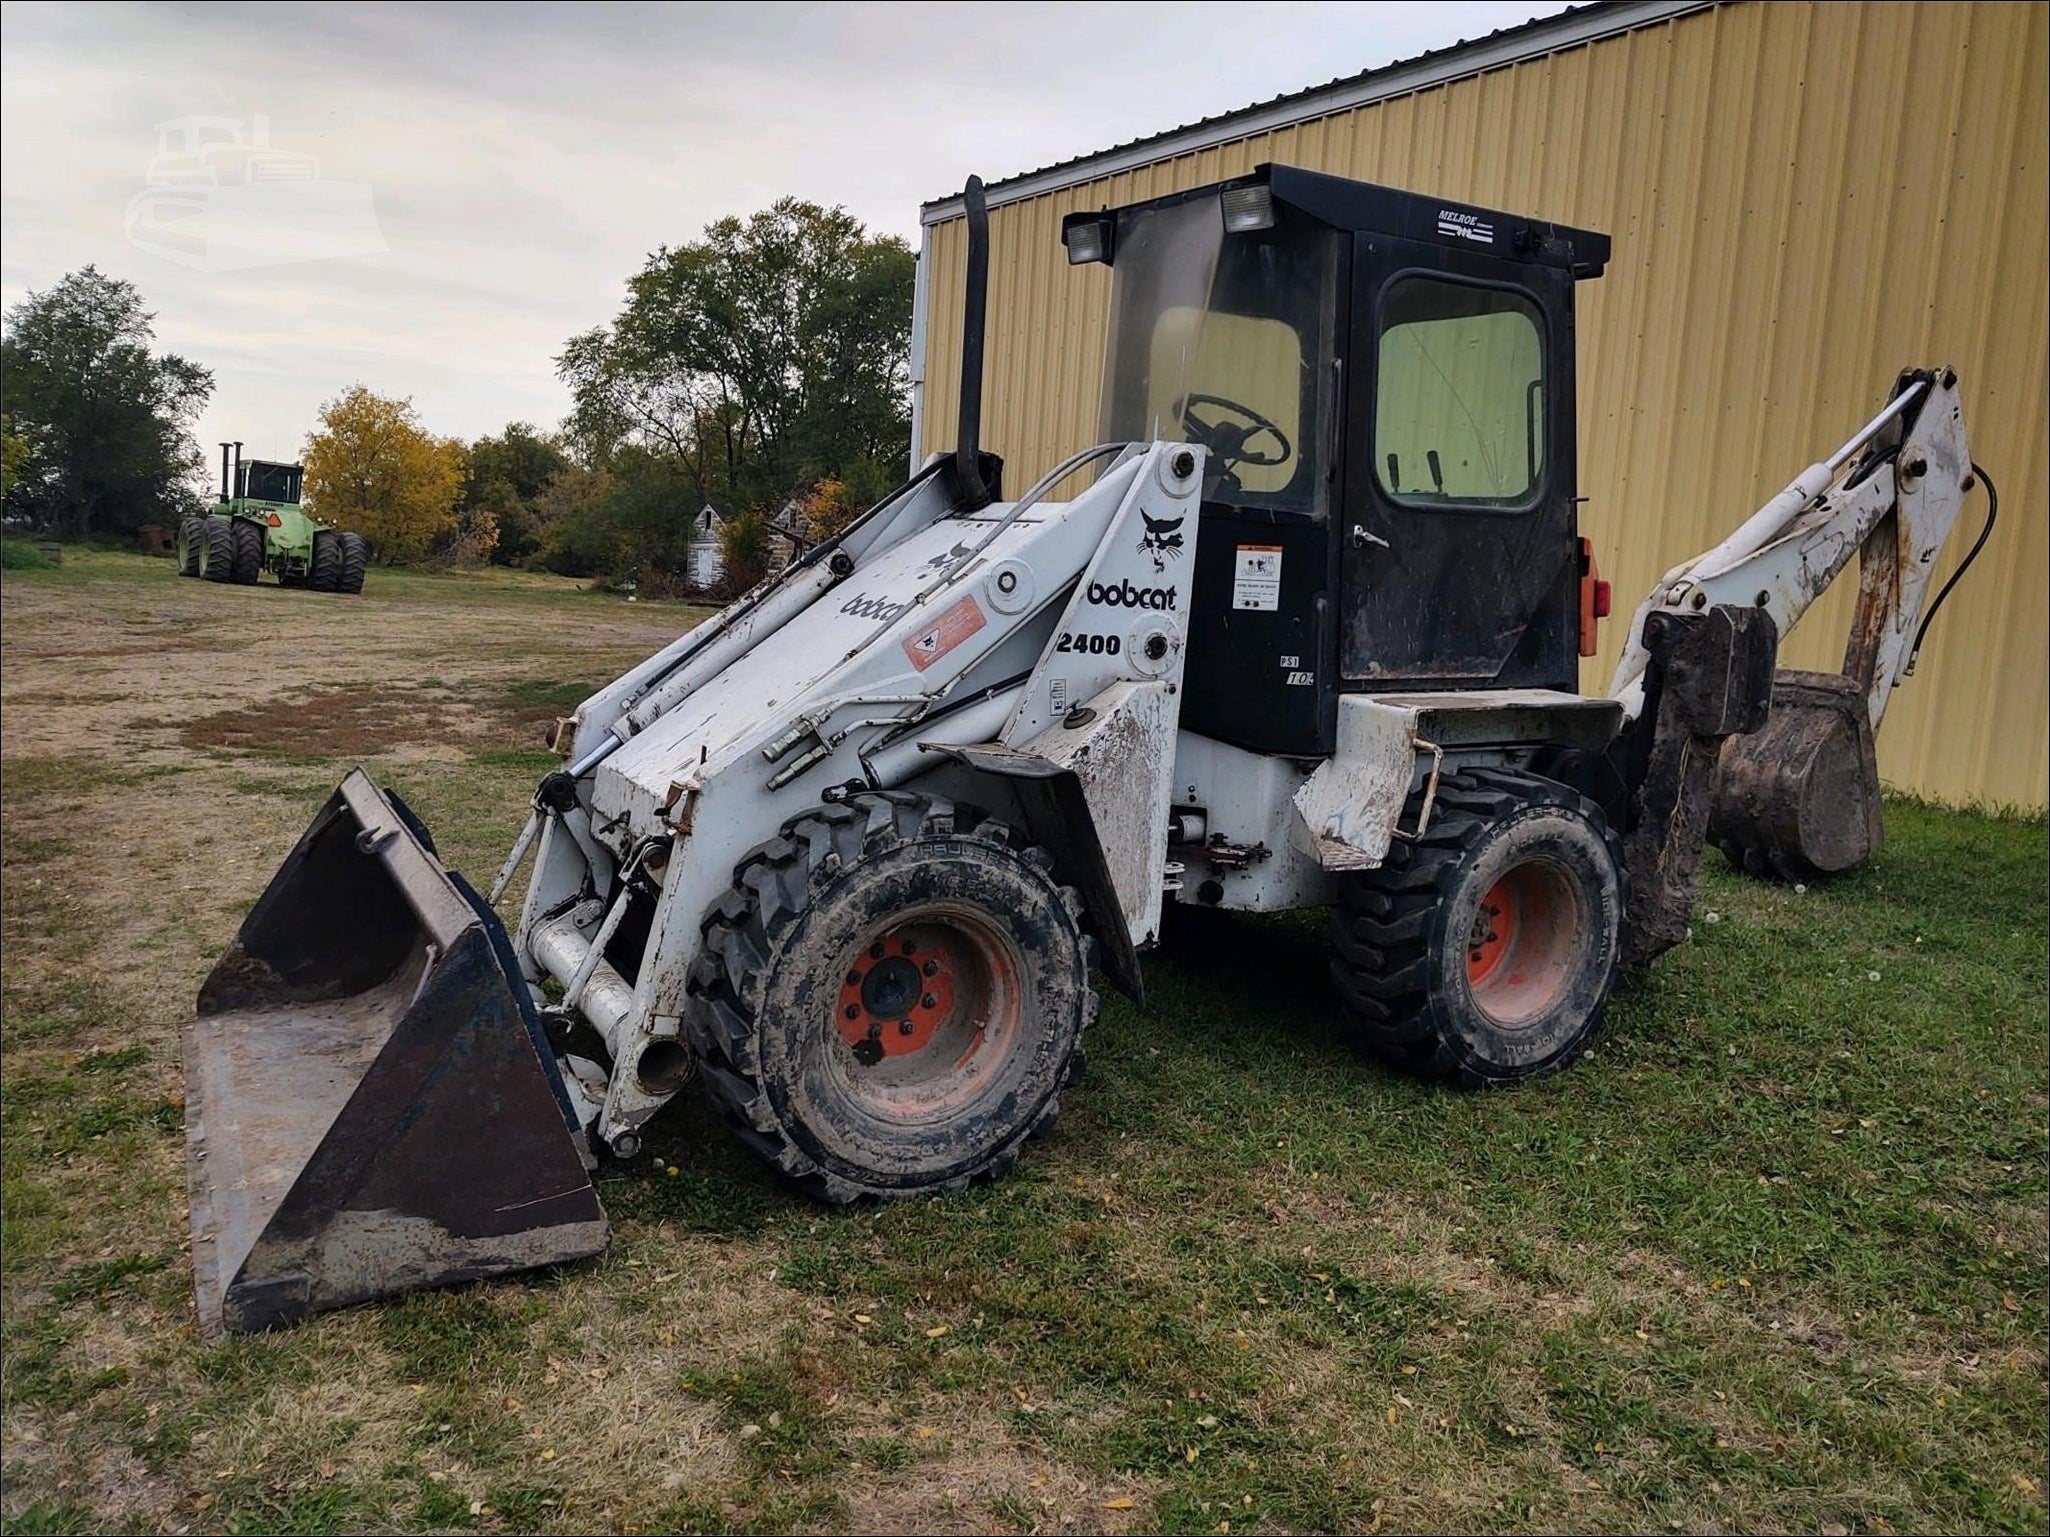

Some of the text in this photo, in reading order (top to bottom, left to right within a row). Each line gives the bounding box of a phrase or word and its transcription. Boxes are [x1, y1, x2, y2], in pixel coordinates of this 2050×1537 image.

[1438, 210, 1478, 226] MELROE
[1087, 579, 1177, 611] bobcat
[840, 592, 905, 621] bobca
[1057, 633, 1120, 655] 2400
[1281, 656, 1298, 667] PSI
